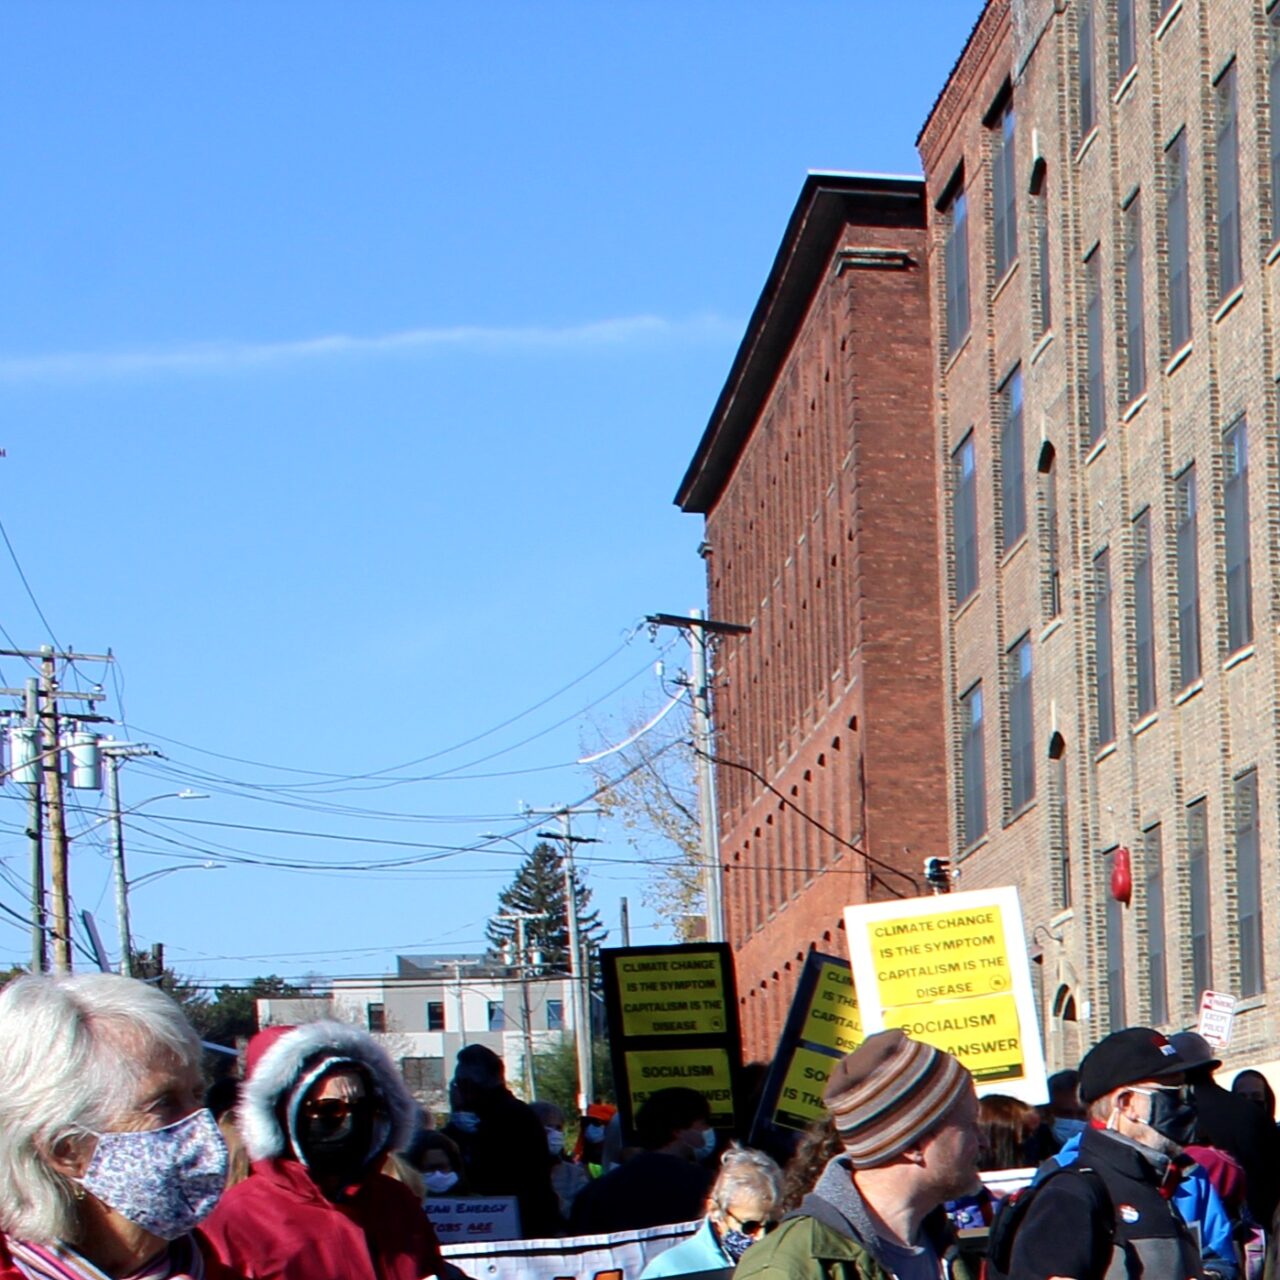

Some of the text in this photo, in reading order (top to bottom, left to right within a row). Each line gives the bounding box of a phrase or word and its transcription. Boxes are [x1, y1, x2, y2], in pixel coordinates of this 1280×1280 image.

[875, 913, 995, 938] CLIMATE CHANGE
[880, 935, 996, 959] IS THE SYMPTOM
[623, 960, 715, 973] CLIMATE CHANGE
[878, 956, 1005, 982] CAPITALISM IS THE
[627, 980, 717, 992] IS THE SYMPTOM
[917, 982, 974, 999] DISEASE
[823, 991, 834, 1001] IS
[624, 1000, 722, 1013] CAPITALISM IS THE
[652, 1021, 697, 1032] DISEASE
[811, 1009, 863, 1032] CAPITAL
[902, 1014, 996, 1036] SOCIALISM
[947, 1038, 1018, 1057] ANSWER
[642, 1065, 714, 1078] SOCIALISM
[633, 1092, 645, 1103] IS
[783, 1088, 798, 1101] IS
[456, 1202, 508, 1215] ENERGY
[467, 1221, 493, 1235] ARE
